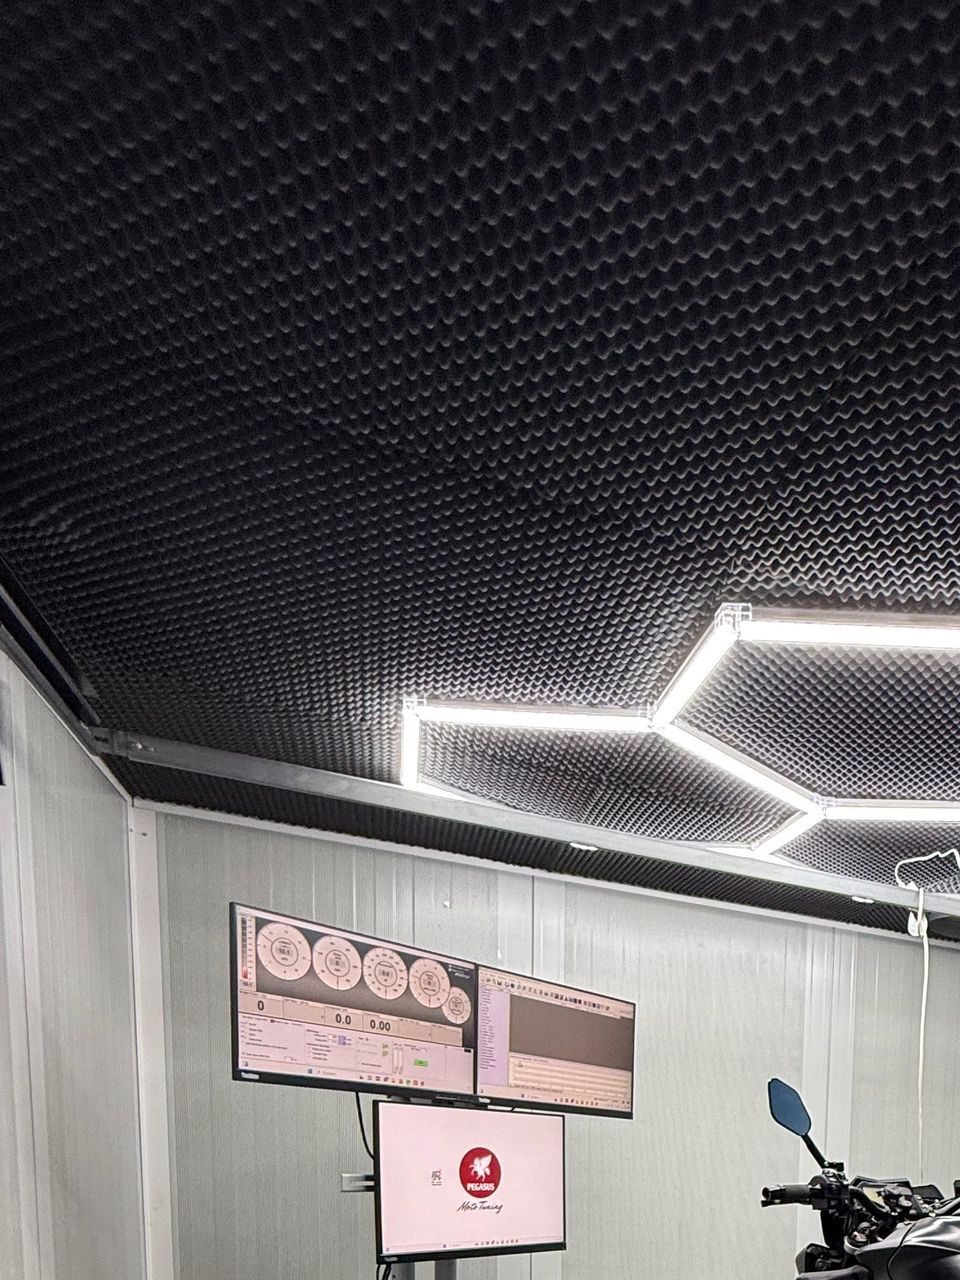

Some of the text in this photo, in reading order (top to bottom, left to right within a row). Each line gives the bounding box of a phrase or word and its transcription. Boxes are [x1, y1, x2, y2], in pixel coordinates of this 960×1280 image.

[257, 1000, 265, 1011] 0
[335, 1013, 352, 1025] 0.0
[369, 1019, 391, 1031] 0.00
[466, 1182, 496, 1192] PEGASUS
[456, 1200, 504, 1215] Moto Tuning
